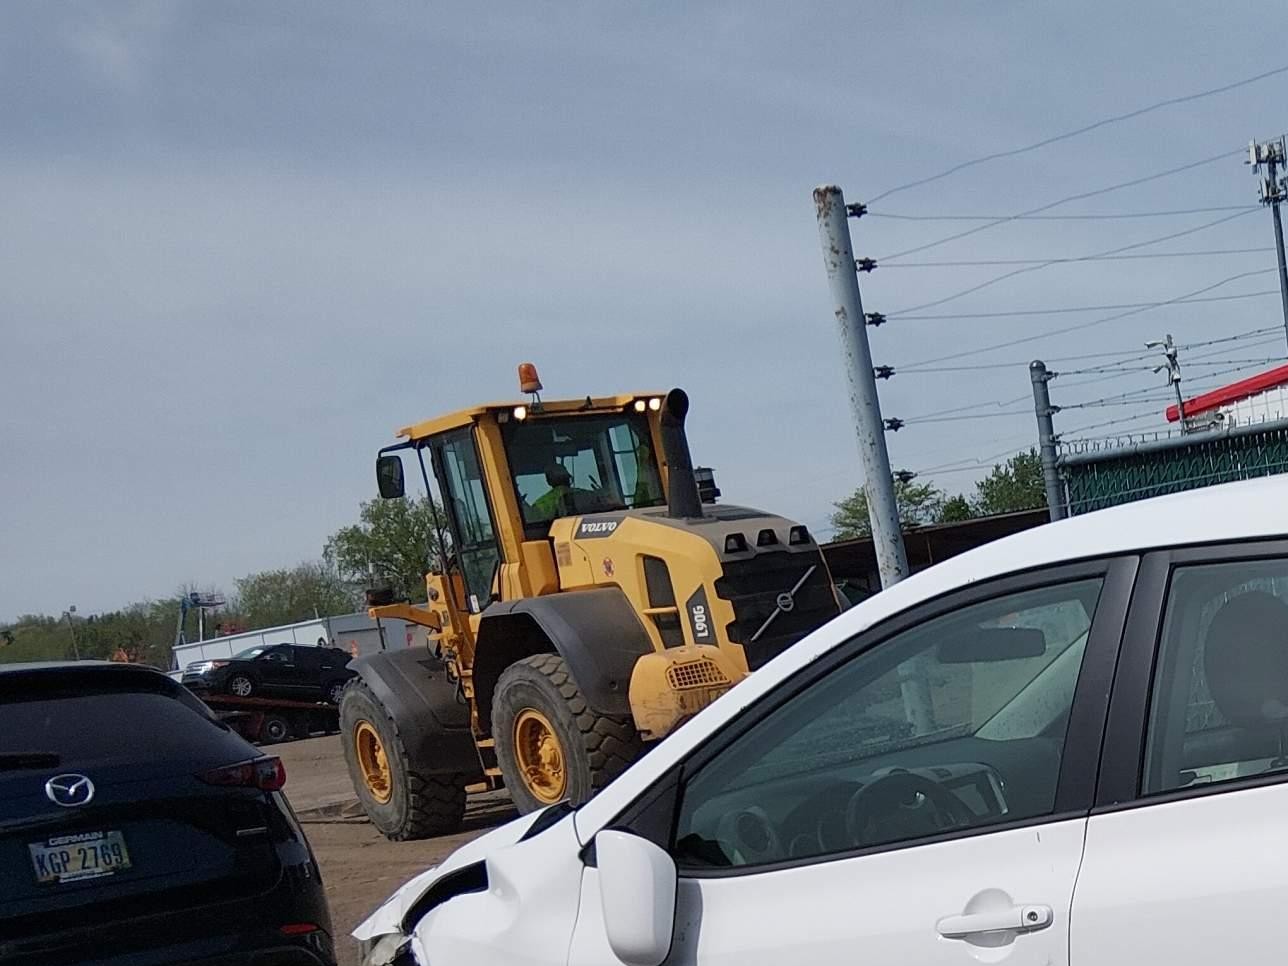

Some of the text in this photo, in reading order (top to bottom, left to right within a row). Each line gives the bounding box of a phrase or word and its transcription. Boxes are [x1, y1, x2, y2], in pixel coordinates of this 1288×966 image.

[581, 521, 617, 533] VOLVO
[692, 605, 709, 638] L90G
[48, 831, 104, 846] GERMAIN
[36, 842, 124, 877] KGP 2769
